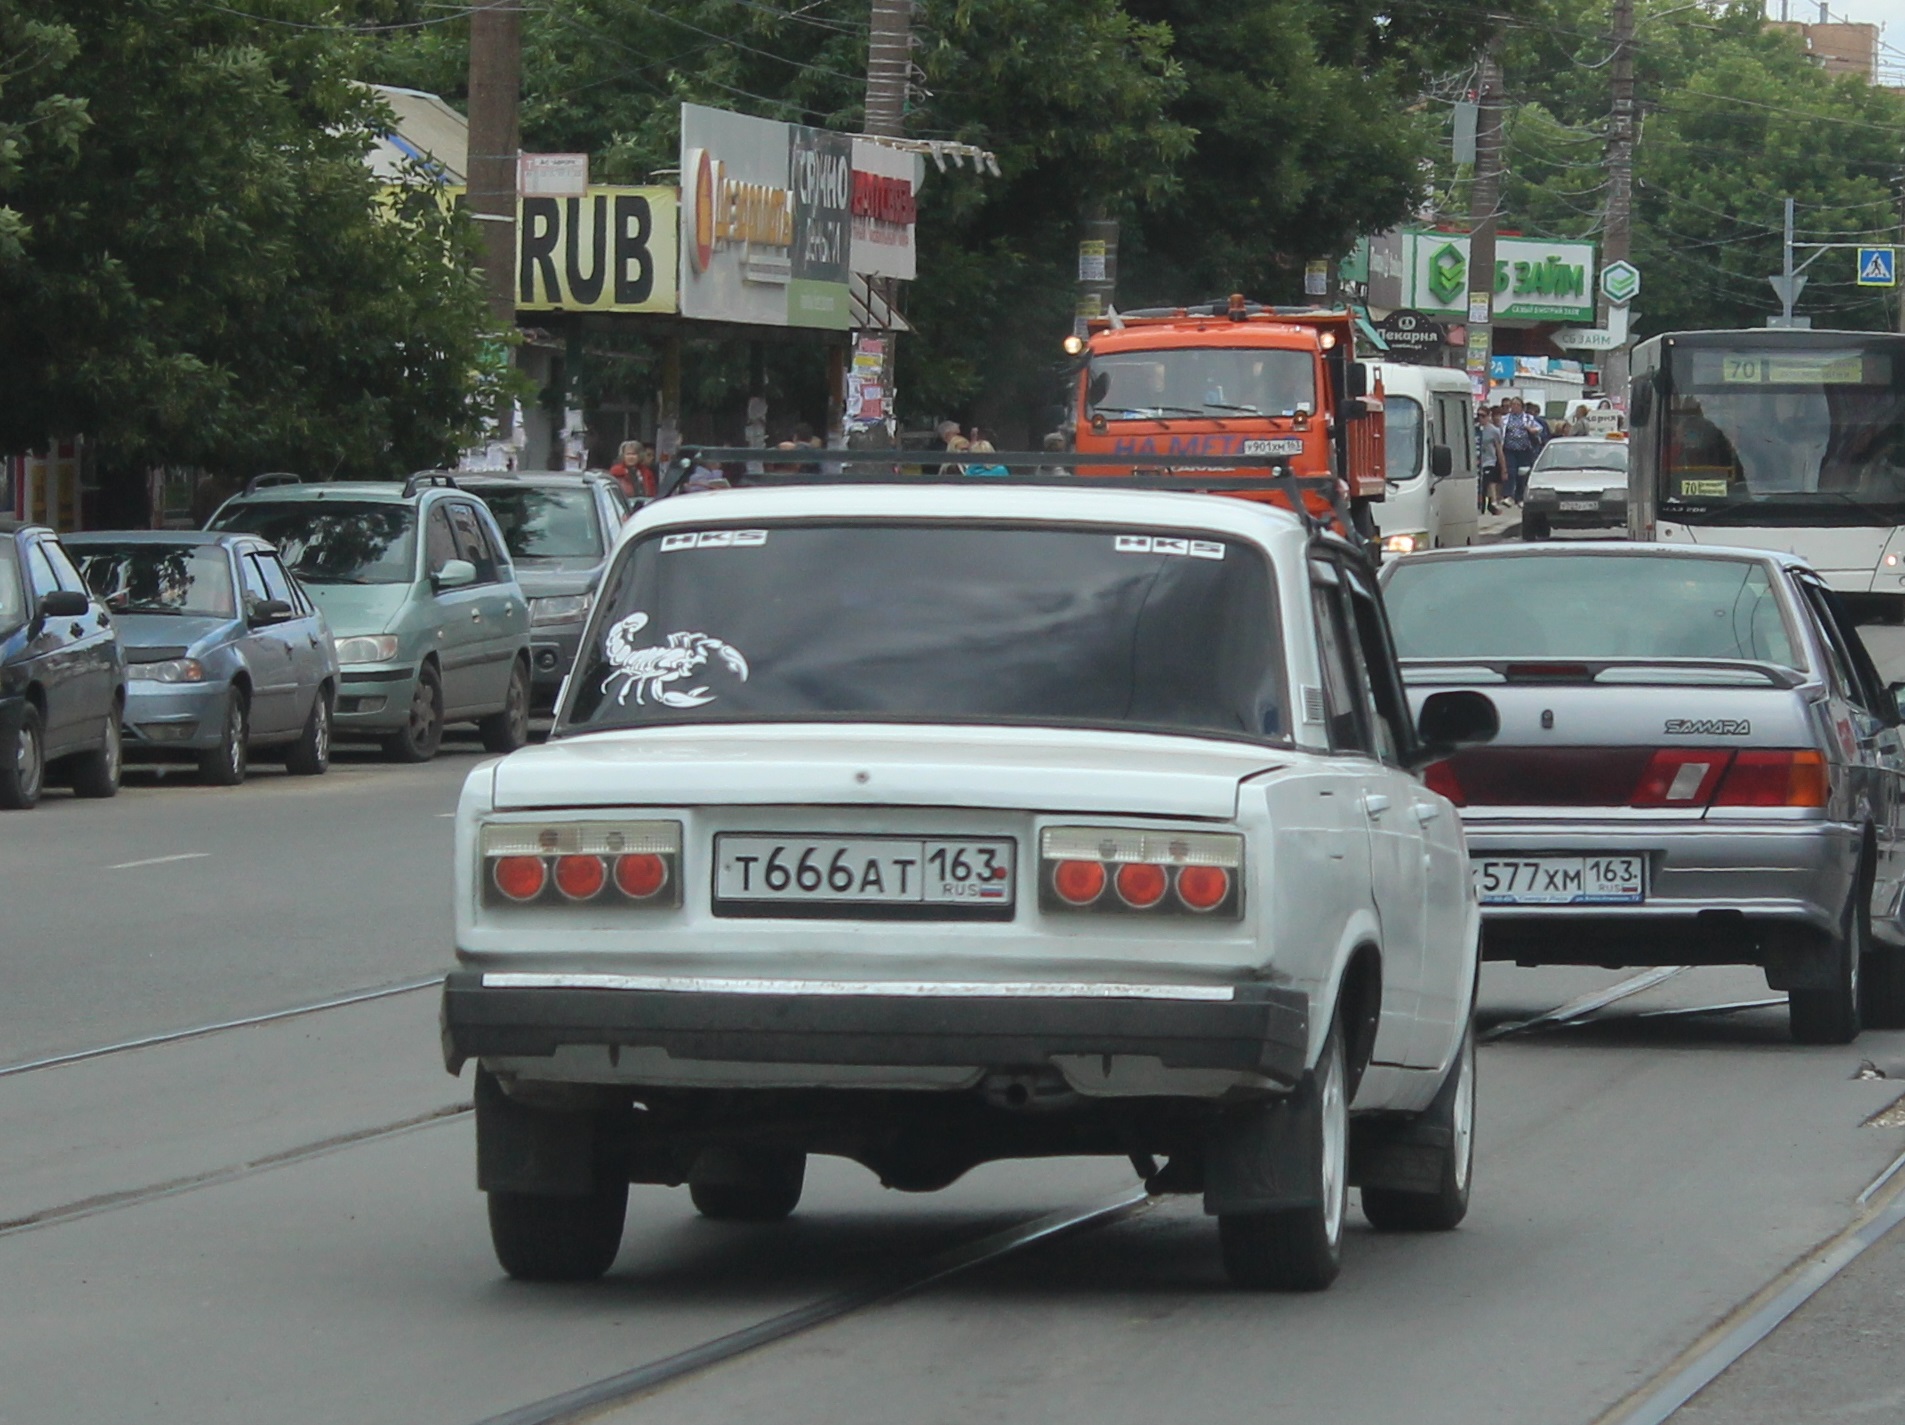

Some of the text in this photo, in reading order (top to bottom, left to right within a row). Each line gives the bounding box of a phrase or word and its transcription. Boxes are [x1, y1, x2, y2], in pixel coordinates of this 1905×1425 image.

[1513, 255, 1584, 297] ЗАЙМ
[1376, 328, 1438, 344] Пекарня
[1562, 334, 1611, 345] СБ ЗАЙМ
[1731, 360, 1756, 379] 70
[1114, 436, 1158, 456] НА
[1684, 481, 1697, 495] 70
[662, 530, 767, 550] HKS
[1117, 536, 1223, 557] HKS
[1664, 719, 1751, 735] SAMARA
[735, 846, 998, 894] Т666АТ 163
[1472, 860, 1634, 892] 577ХМ 163
[942, 884, 978, 897] RUS
[1598, 883, 1621, 893] RUS
